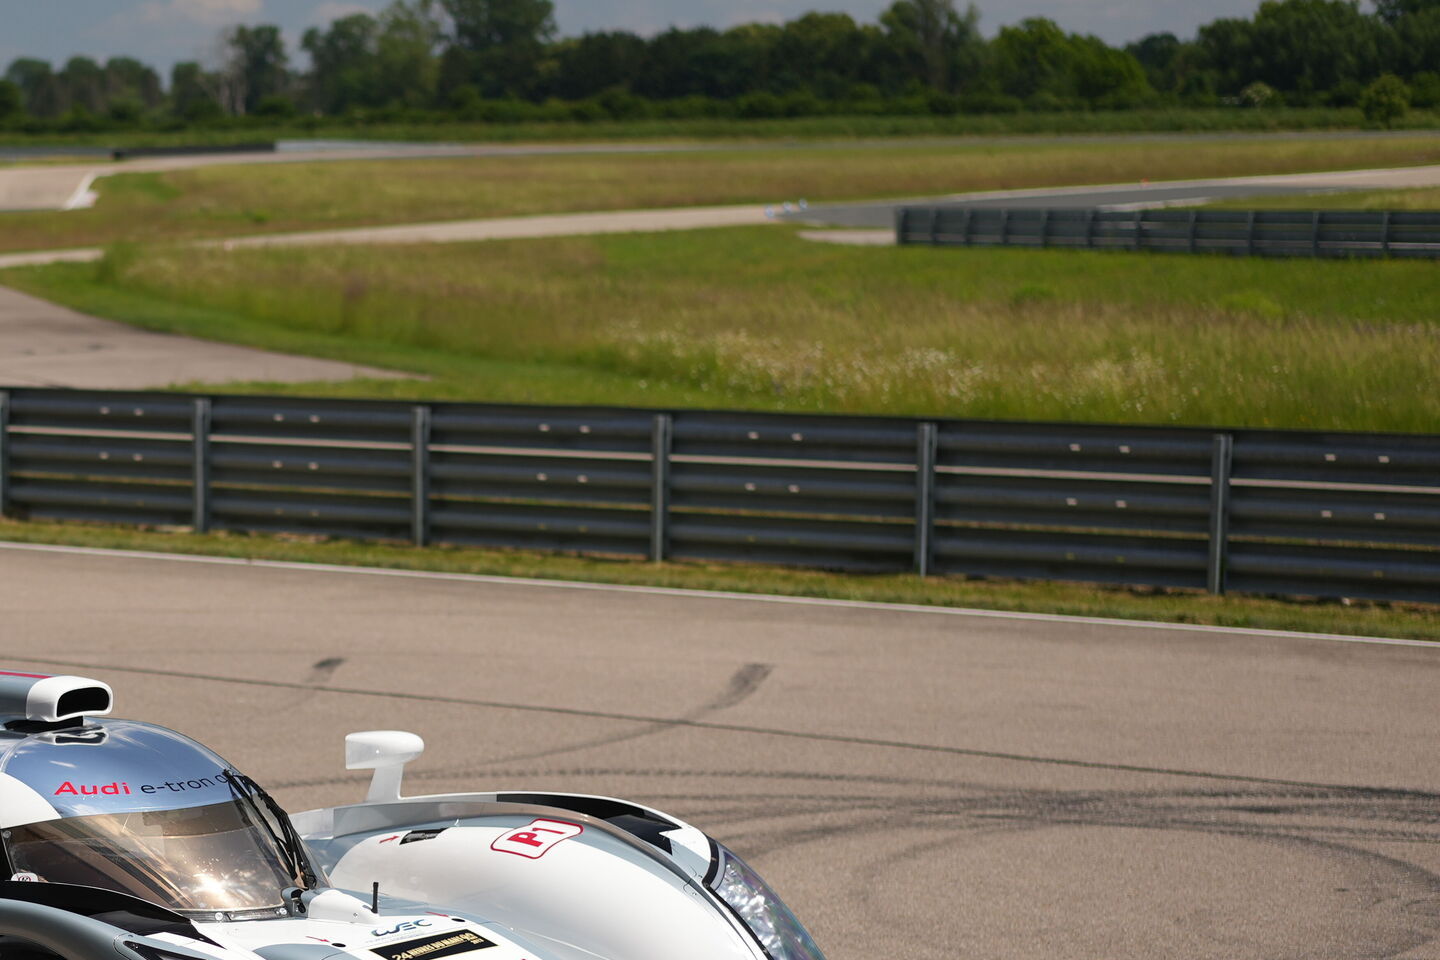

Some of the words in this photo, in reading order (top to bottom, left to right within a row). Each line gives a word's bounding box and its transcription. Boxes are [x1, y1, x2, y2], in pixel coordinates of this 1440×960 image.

[54, 781, 131, 795] Audi
[140, 776, 214, 794] e-tron
[506, 827, 566, 848] P1
[371, 919, 433, 936] WEC
